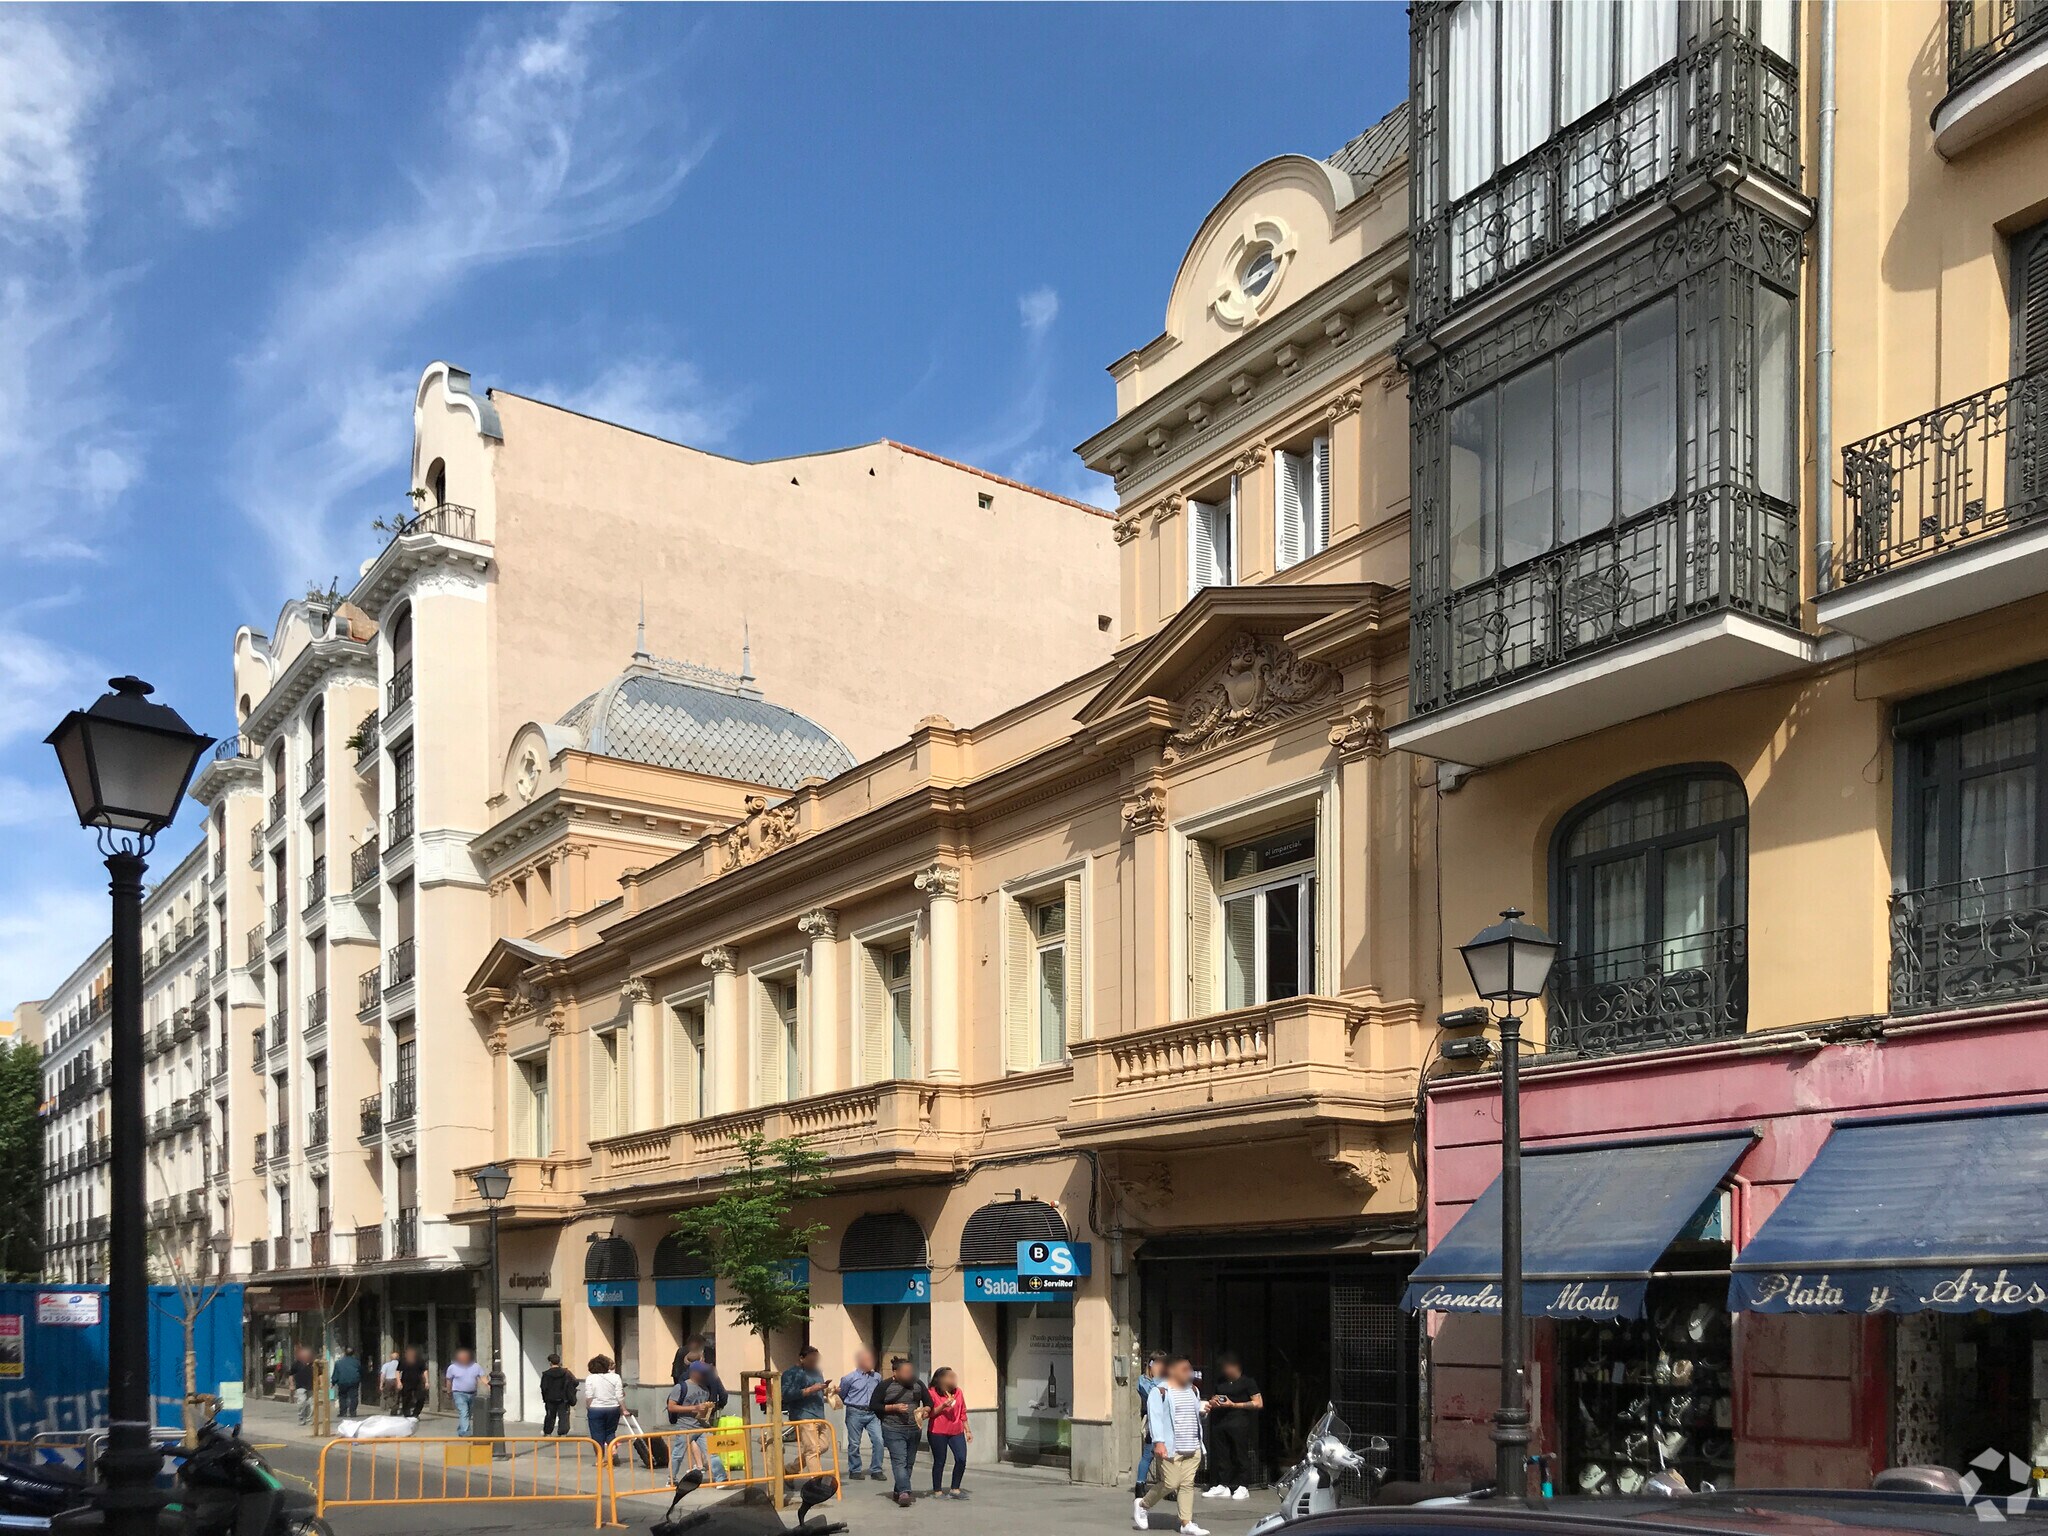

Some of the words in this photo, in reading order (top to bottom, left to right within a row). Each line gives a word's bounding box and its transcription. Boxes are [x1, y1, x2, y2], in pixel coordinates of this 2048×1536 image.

[1034, 1247, 1044, 1259] B
[1050, 1247, 1072, 1274] S
[916, 1280, 925, 1296] S
[984, 1277, 1040, 1295] Saba
[1043, 1279, 1073, 1288] ServiRed
[1751, 1273, 1845, 1306] Plata
[1865, 1286, 1894, 1313] y
[1920, 1268, 2048, 1305] Artes
[1420, 1283, 1502, 1308] Ganda
[1546, 1282, 1620, 1311] Moda
